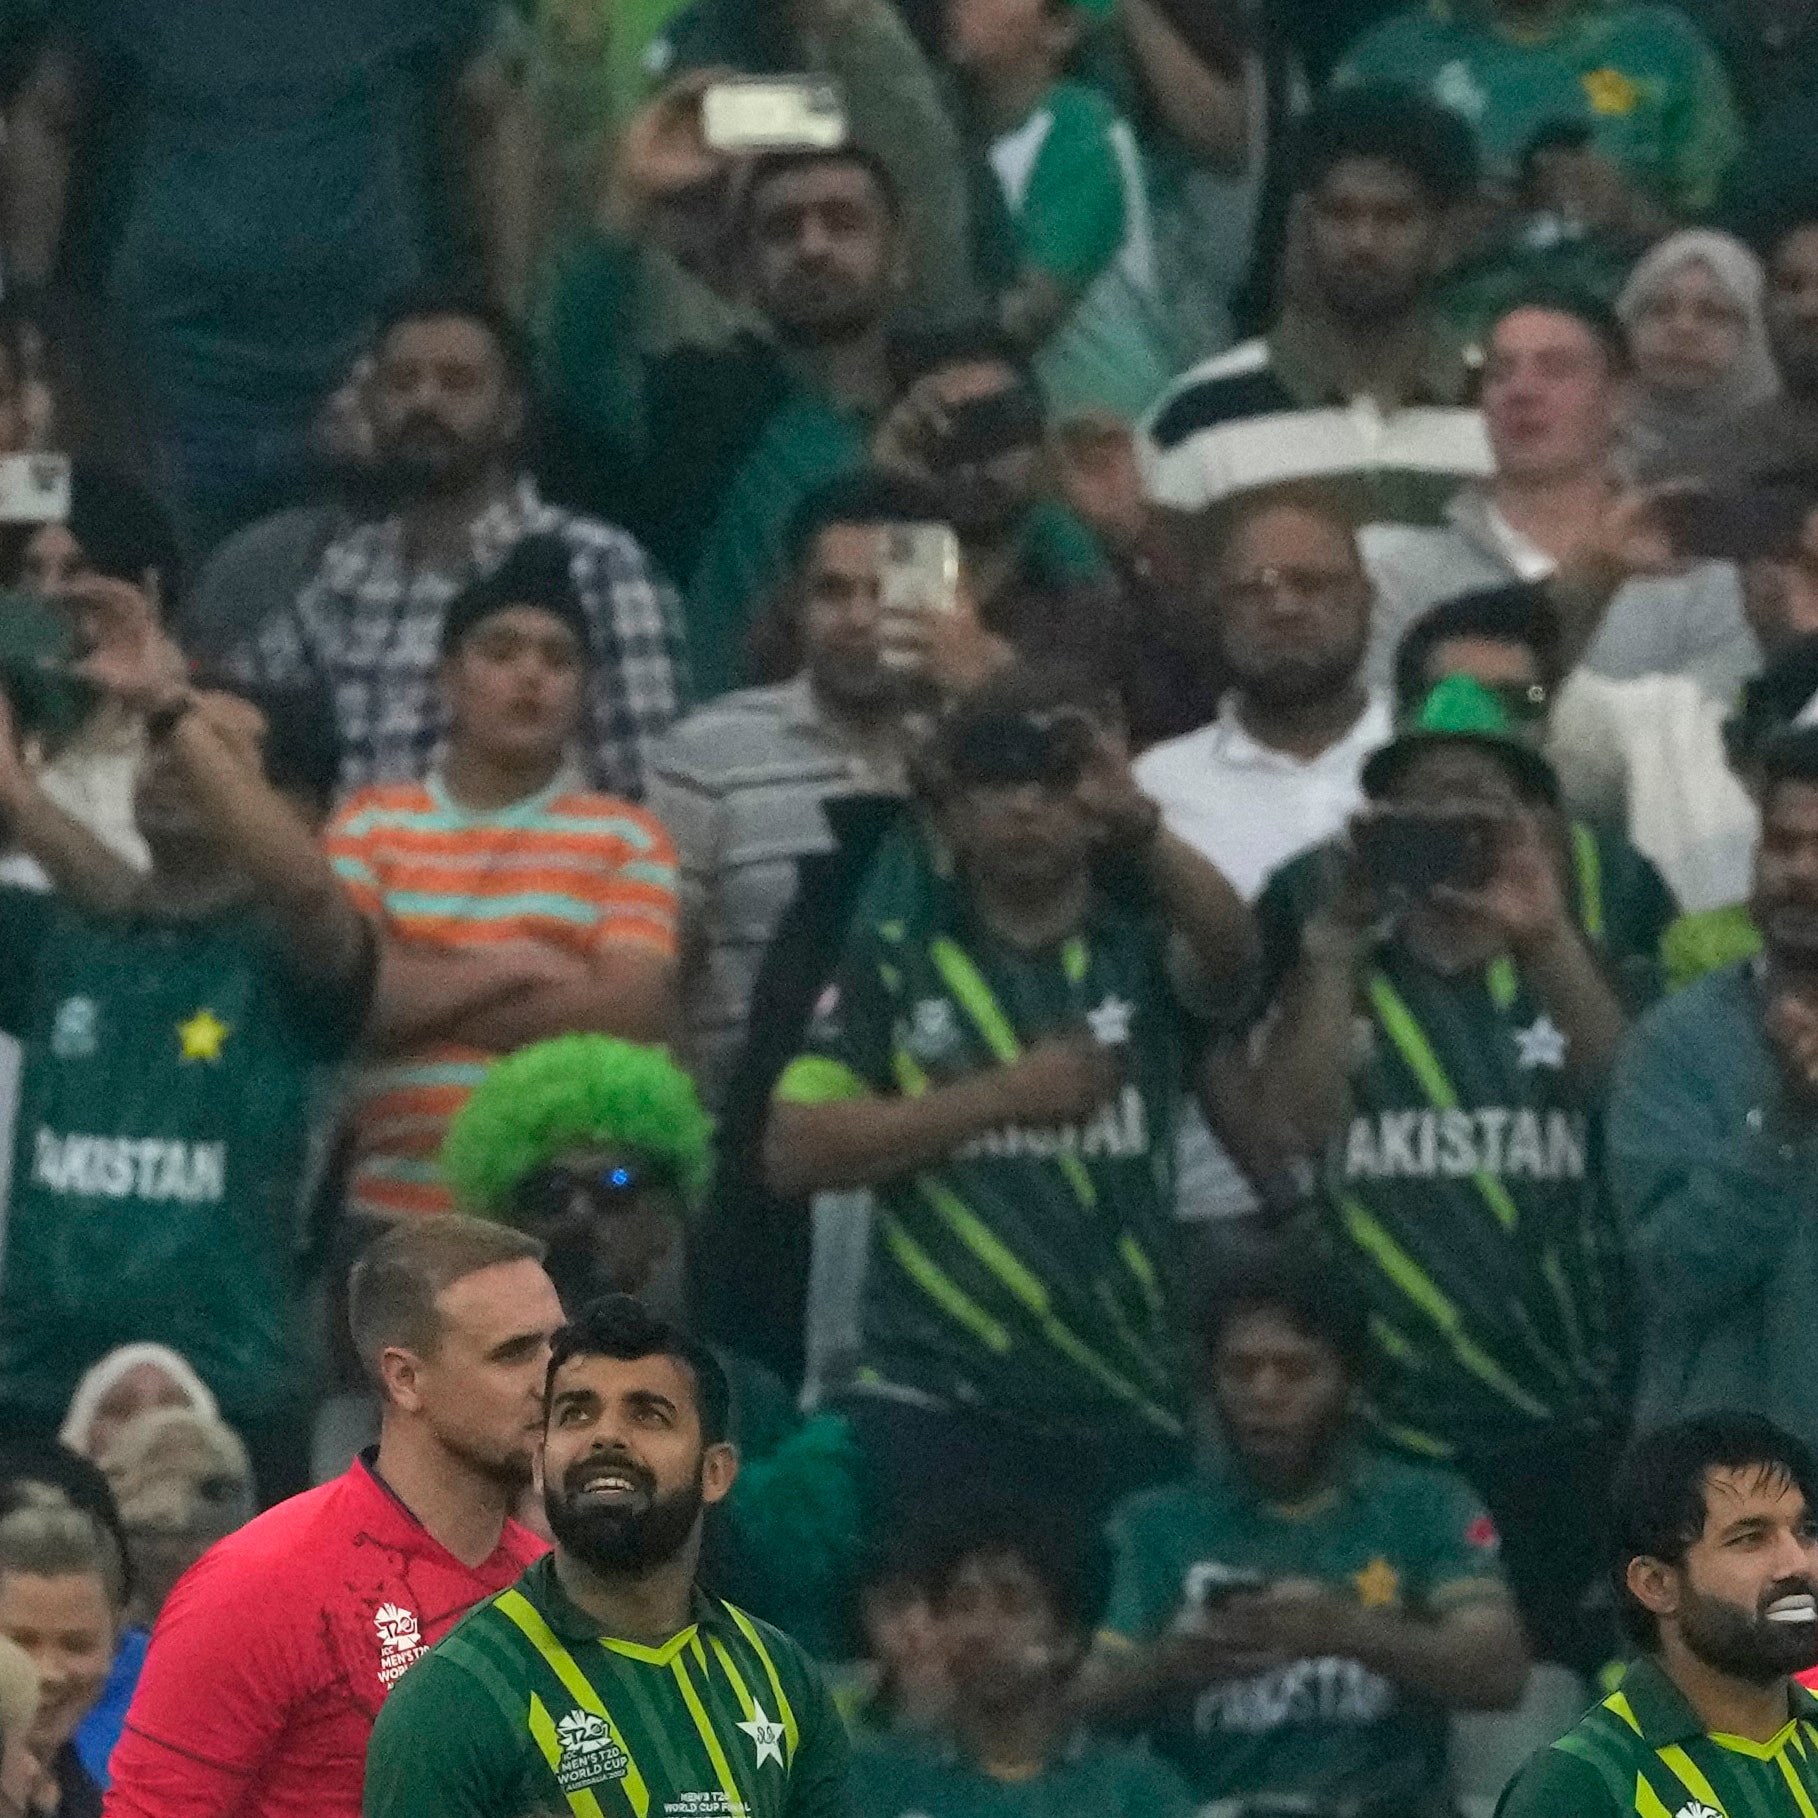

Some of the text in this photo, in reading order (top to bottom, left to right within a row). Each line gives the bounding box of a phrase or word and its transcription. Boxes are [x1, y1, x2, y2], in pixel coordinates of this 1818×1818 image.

[557, 1756, 628, 1785] WORLD CUP
[561, 1747, 619, 1772] MEN'S T20
[699, 1803, 720, 1812] CUP
